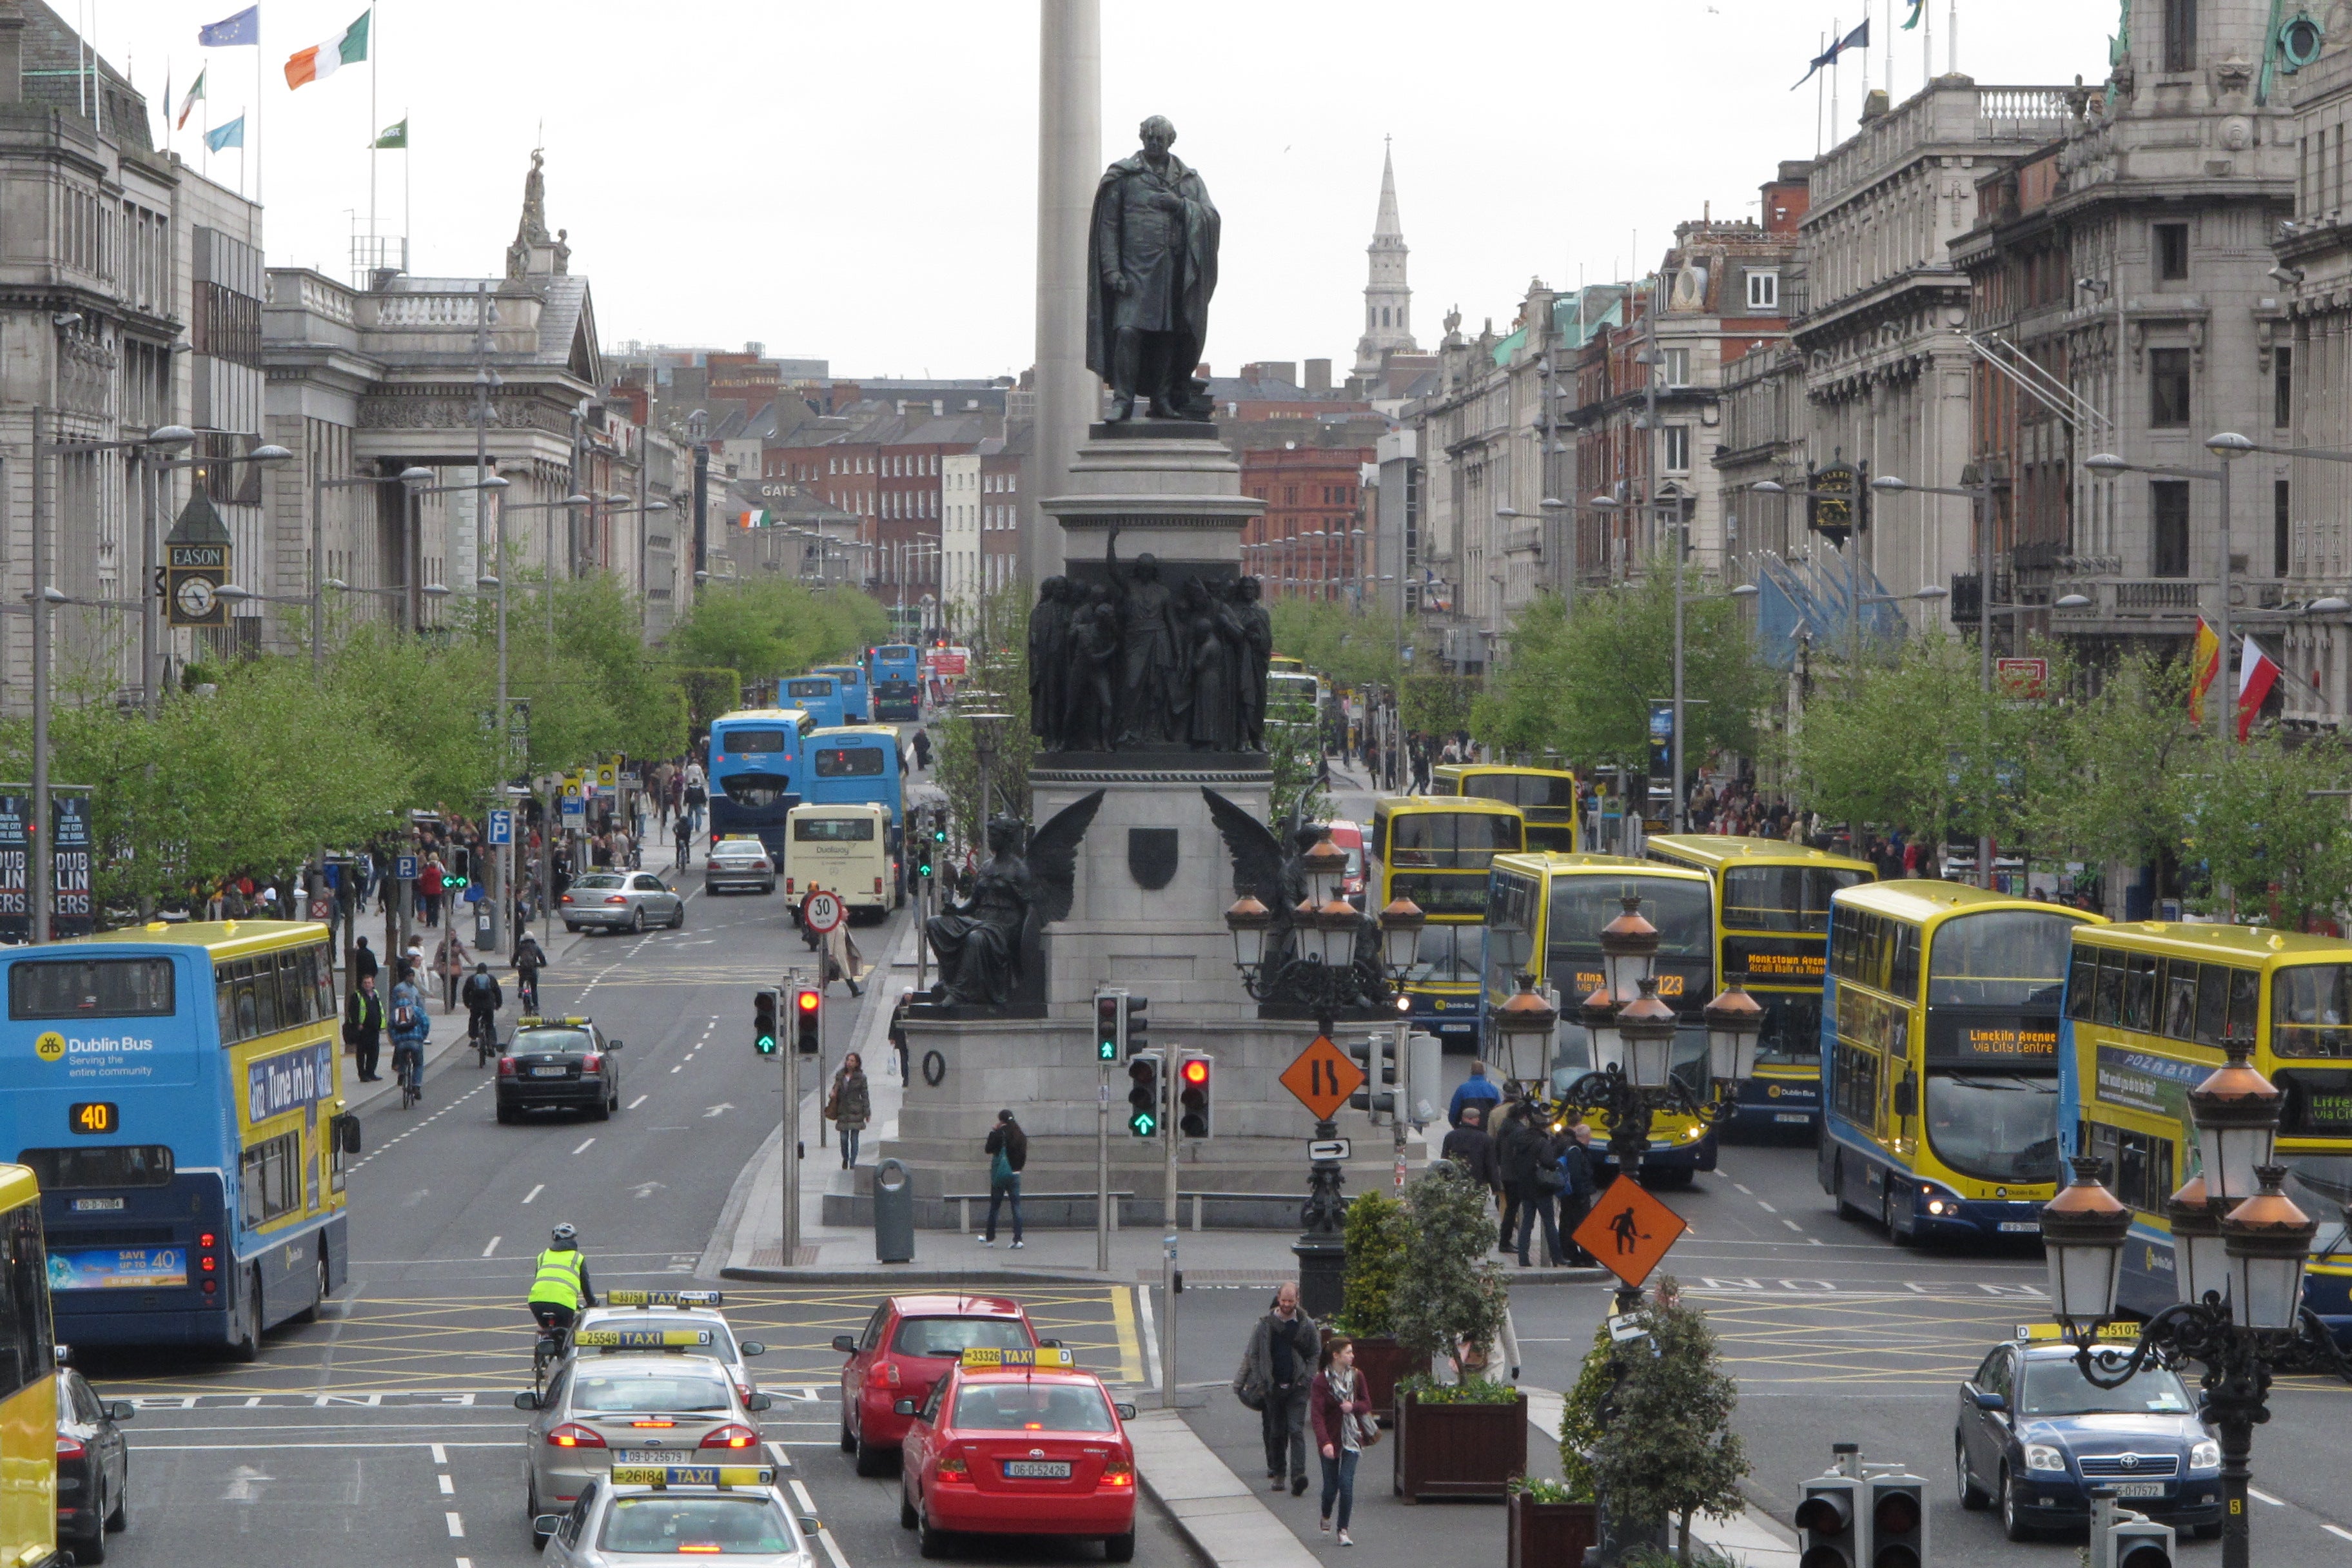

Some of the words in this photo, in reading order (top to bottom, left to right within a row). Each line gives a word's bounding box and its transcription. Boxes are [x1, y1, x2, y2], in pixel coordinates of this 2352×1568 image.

[761, 485, 796, 497] GATE
[174, 549, 220, 565] EASON
[0, 851, 25, 870] UB
[56, 852, 88, 871] DUB
[57, 871, 88, 890] LIN
[57, 894, 89, 914] ERS
[815, 898, 830, 916] 30
[1749, 954, 1799, 965] Monkstown
[1576, 972, 1605, 982] Kilna
[1577, 983, 1592, 992] via
[1657, 975, 1684, 995] 123
[1970, 1030, 2015, 1041] Limekiln
[2019, 1032, 2056, 1042] Avenue
[68, 1038, 119, 1053] Dublin
[122, 1037, 153, 1051] Bus
[1974, 1042, 1990, 1052] via
[1993, 1041, 2014, 1052] City
[2017, 1041, 2053, 1053] Centre
[69, 1055, 106, 1066] Serving
[108, 1055, 124, 1064] the
[69, 1068, 97, 1077] entire
[99, 1066, 153, 1077] community
[268, 1065, 291, 1109] Tune
[292, 1058, 303, 1101] in
[304, 1057, 314, 1099] to
[2313, 1096, 2351, 1107] Liffe
[81, 1104, 107, 1130] 40
[2315, 1110, 2333, 1119] via
[119, 1250, 146, 1260] SAVE
[651, 1293, 681, 1304] TAXI
[709, 1293, 718, 1302] D
[2019, 1327, 2028, 1337] D
[587, 1333, 617, 1344] 25549
[623, 1332, 660, 1344] TAXI
[699, 1333, 708, 1343] D
[56, 1348, 65, 1358] D
[972, 1350, 1000, 1362] 33326
[1003, 1349, 1032, 1363] TAXI
[1061, 1351, 1070, 1362] D
[629, 1451, 681, 1462] 09-D-25679
[625, 1469, 664, 1483] 26184
[674, 1469, 713, 1483] TAXI
[759, 1471, 770, 1483] D
[1014, 1465, 1066, 1476] 06-D-52426
[2116, 1485, 2158, 1496] 5-D-17572
[2231, 1501, 2239, 1512] 5
